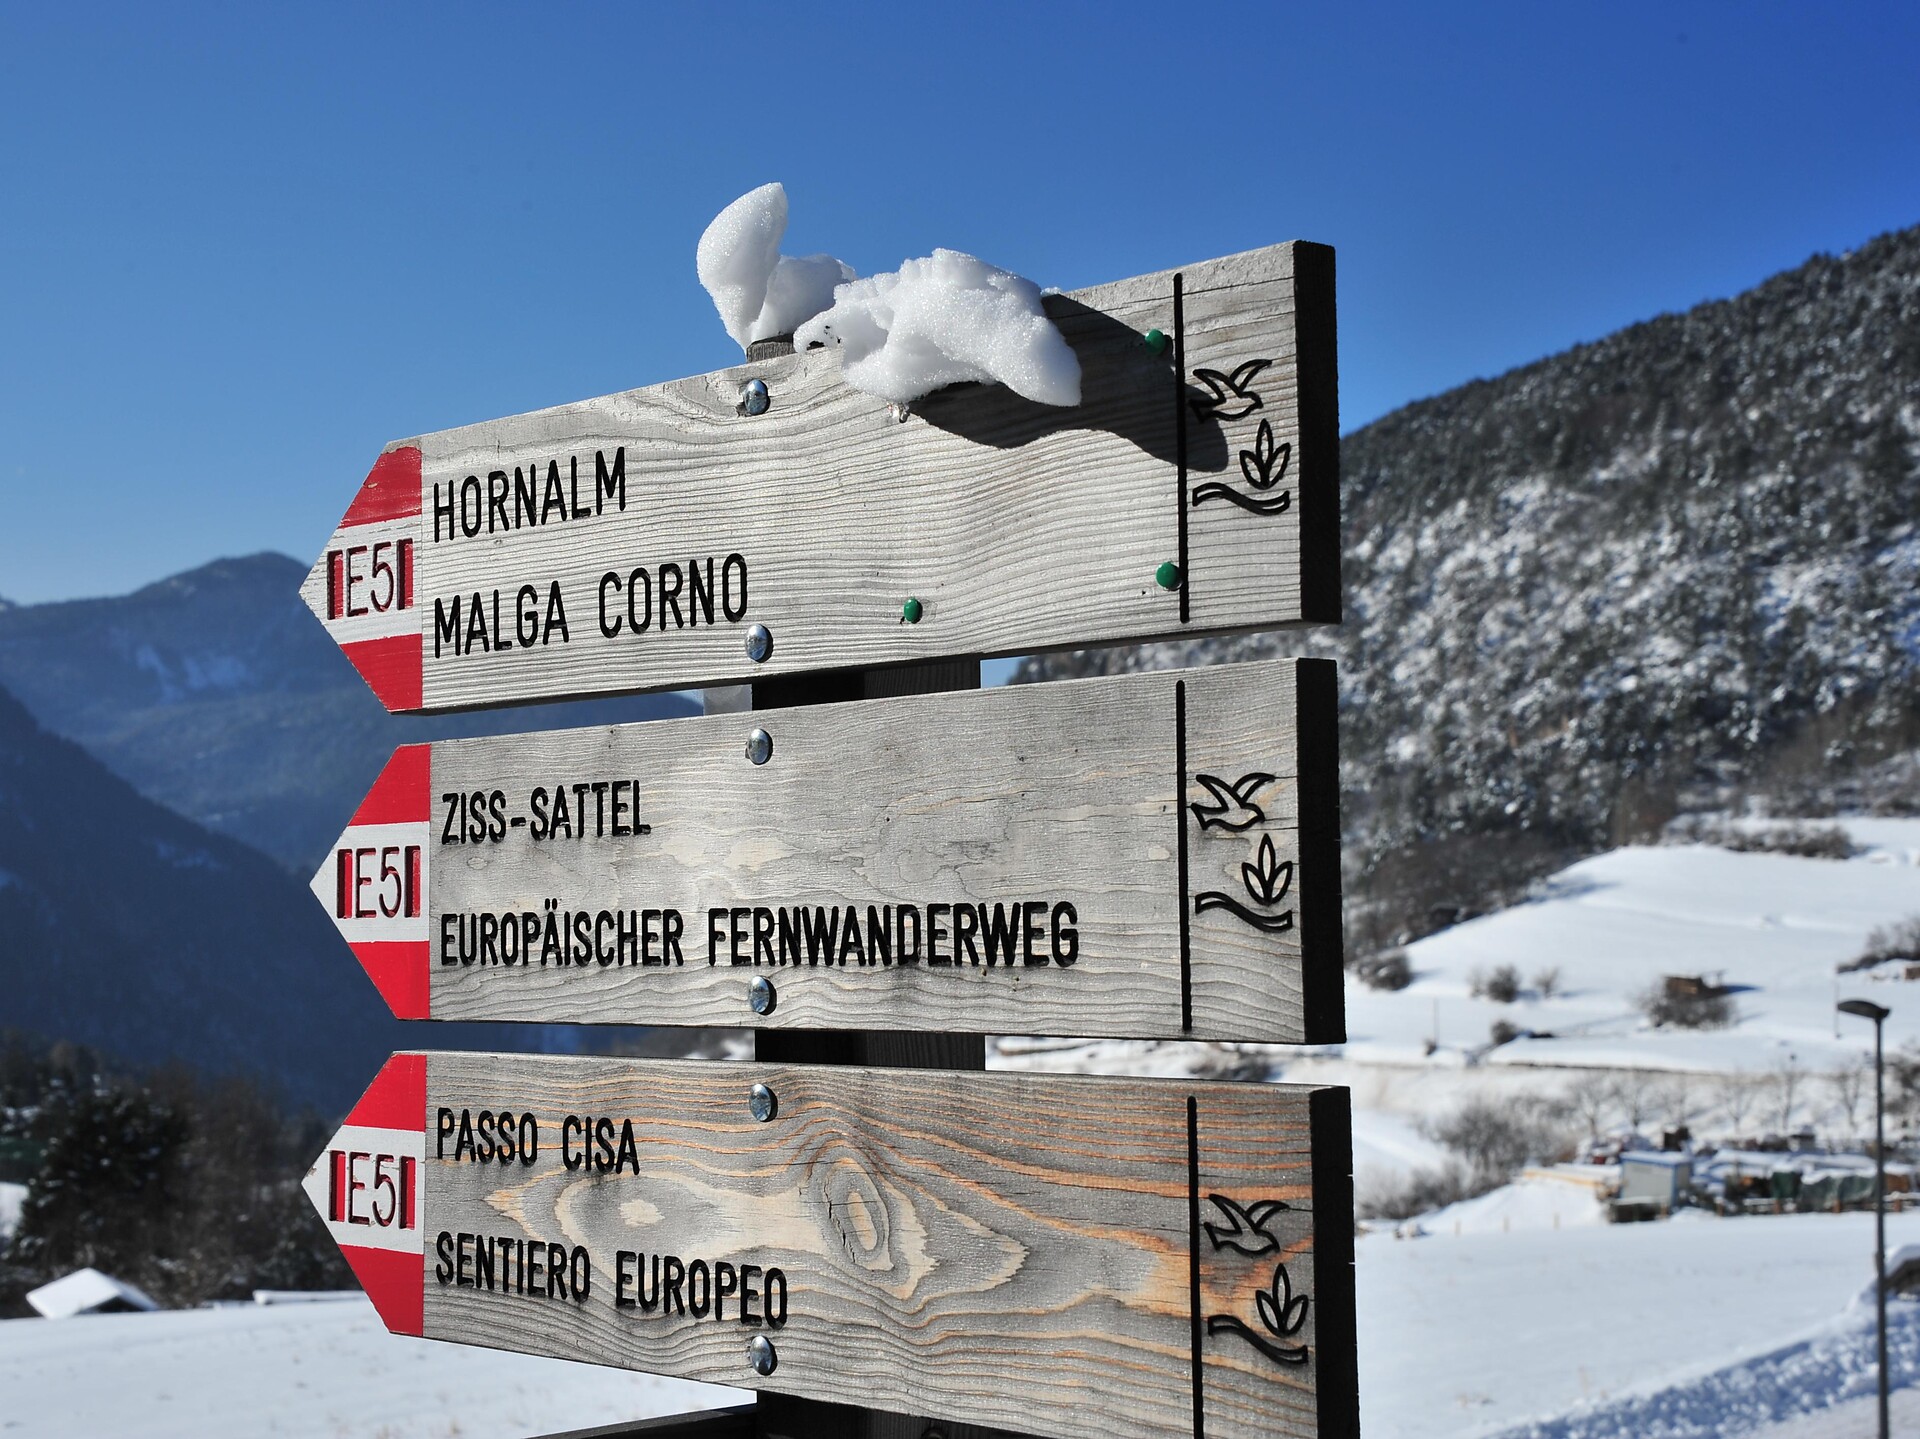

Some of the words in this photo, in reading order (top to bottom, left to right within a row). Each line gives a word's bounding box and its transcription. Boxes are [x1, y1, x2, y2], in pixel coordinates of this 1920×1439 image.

[433, 446, 626, 543] HORNALM
[434, 580, 571, 659] MALGA
[598, 552, 749, 639] CORNO
[441, 779, 652, 845] ZISS-SATTEL
[440, 898, 684, 967] EUROPÄISCHER
[708, 900, 1079, 968] FERNWANDERWEG
[436, 1107, 538, 1166] PASSO
[562, 1115, 640, 1176] CISA
[435, 1230, 591, 1303] SENTIERO
[615, 1250, 788, 1330] EUROPEO
